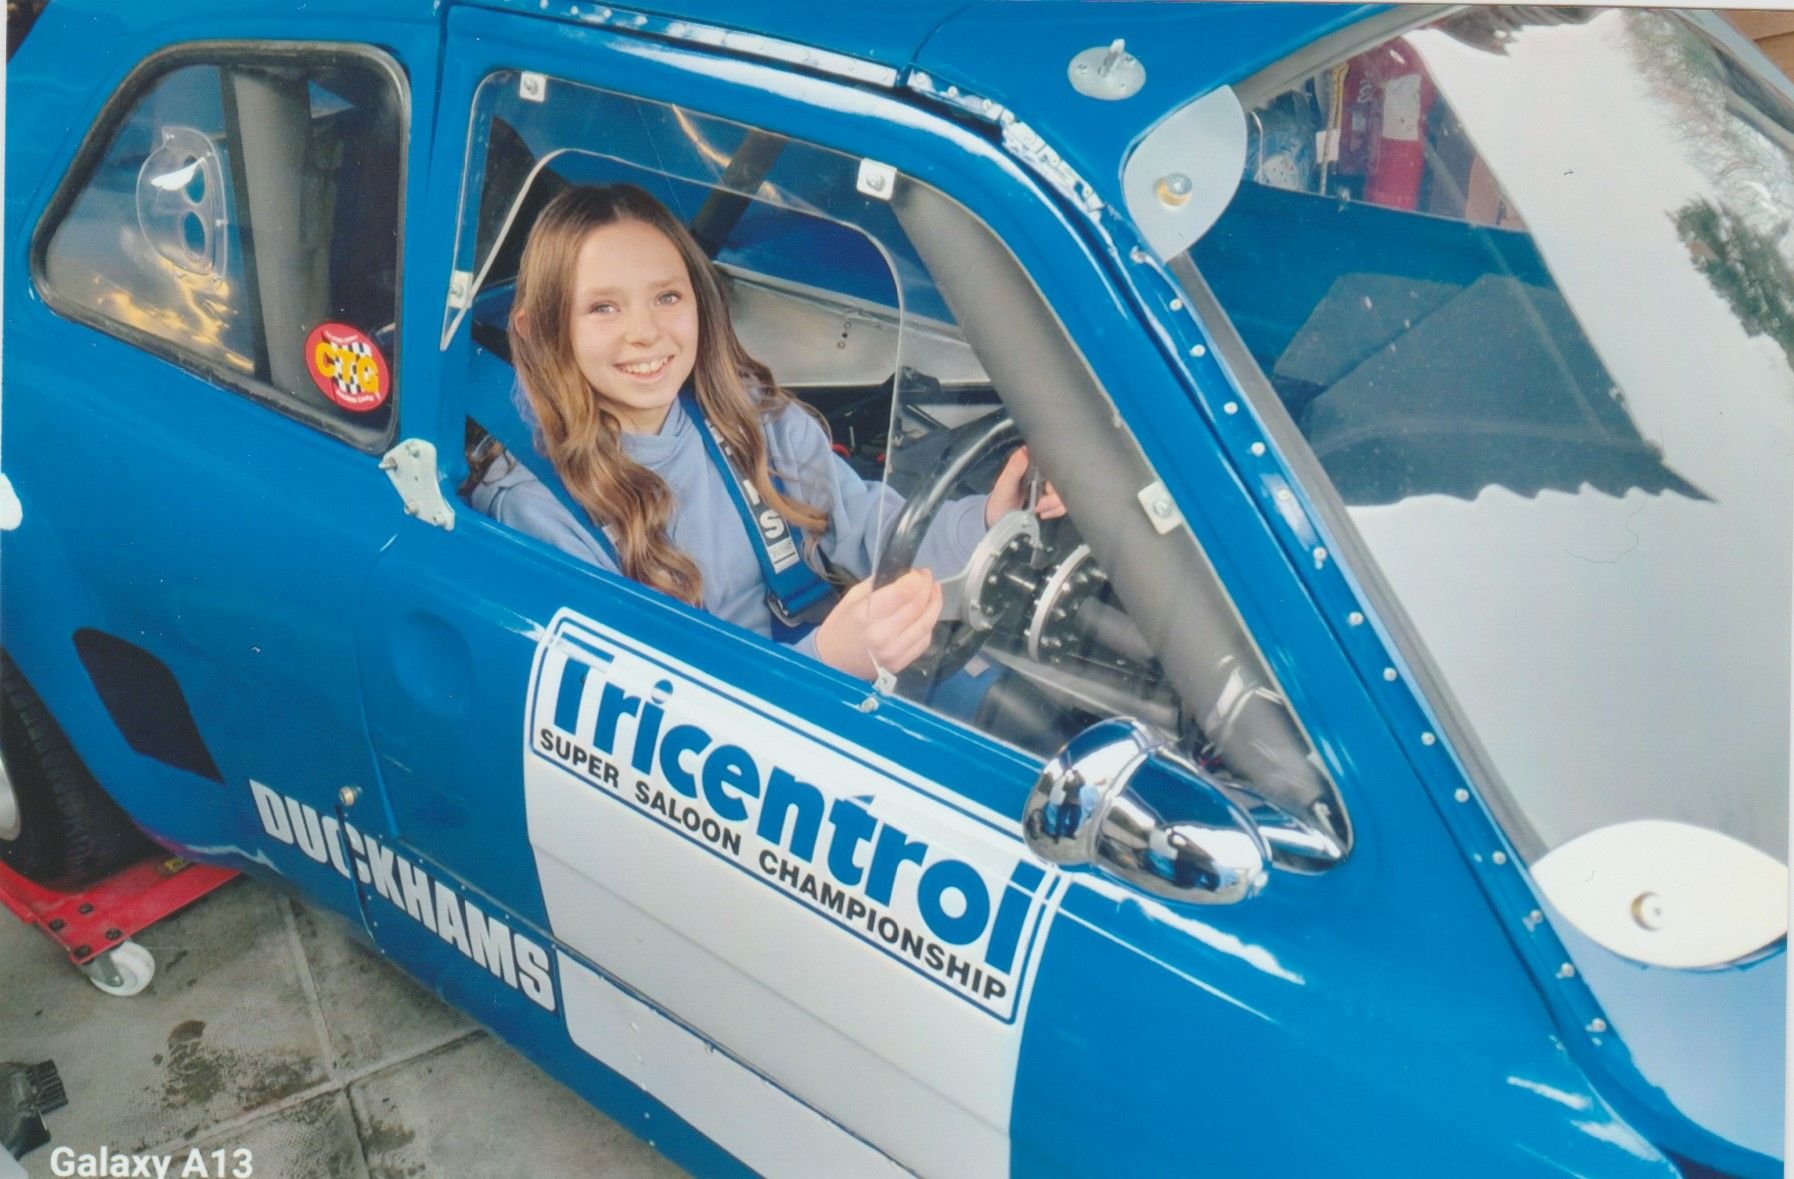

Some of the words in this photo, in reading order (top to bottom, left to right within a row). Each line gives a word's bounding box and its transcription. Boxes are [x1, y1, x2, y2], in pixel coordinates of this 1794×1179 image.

[249, 778, 556, 1012] DUCKHAMS
[540, 728, 620, 789] SUPER
[635, 780, 742, 856] SALOON
[758, 849, 1007, 1001] CHAMPIONSHIP
[553, 631, 1047, 977] Tricentrol
